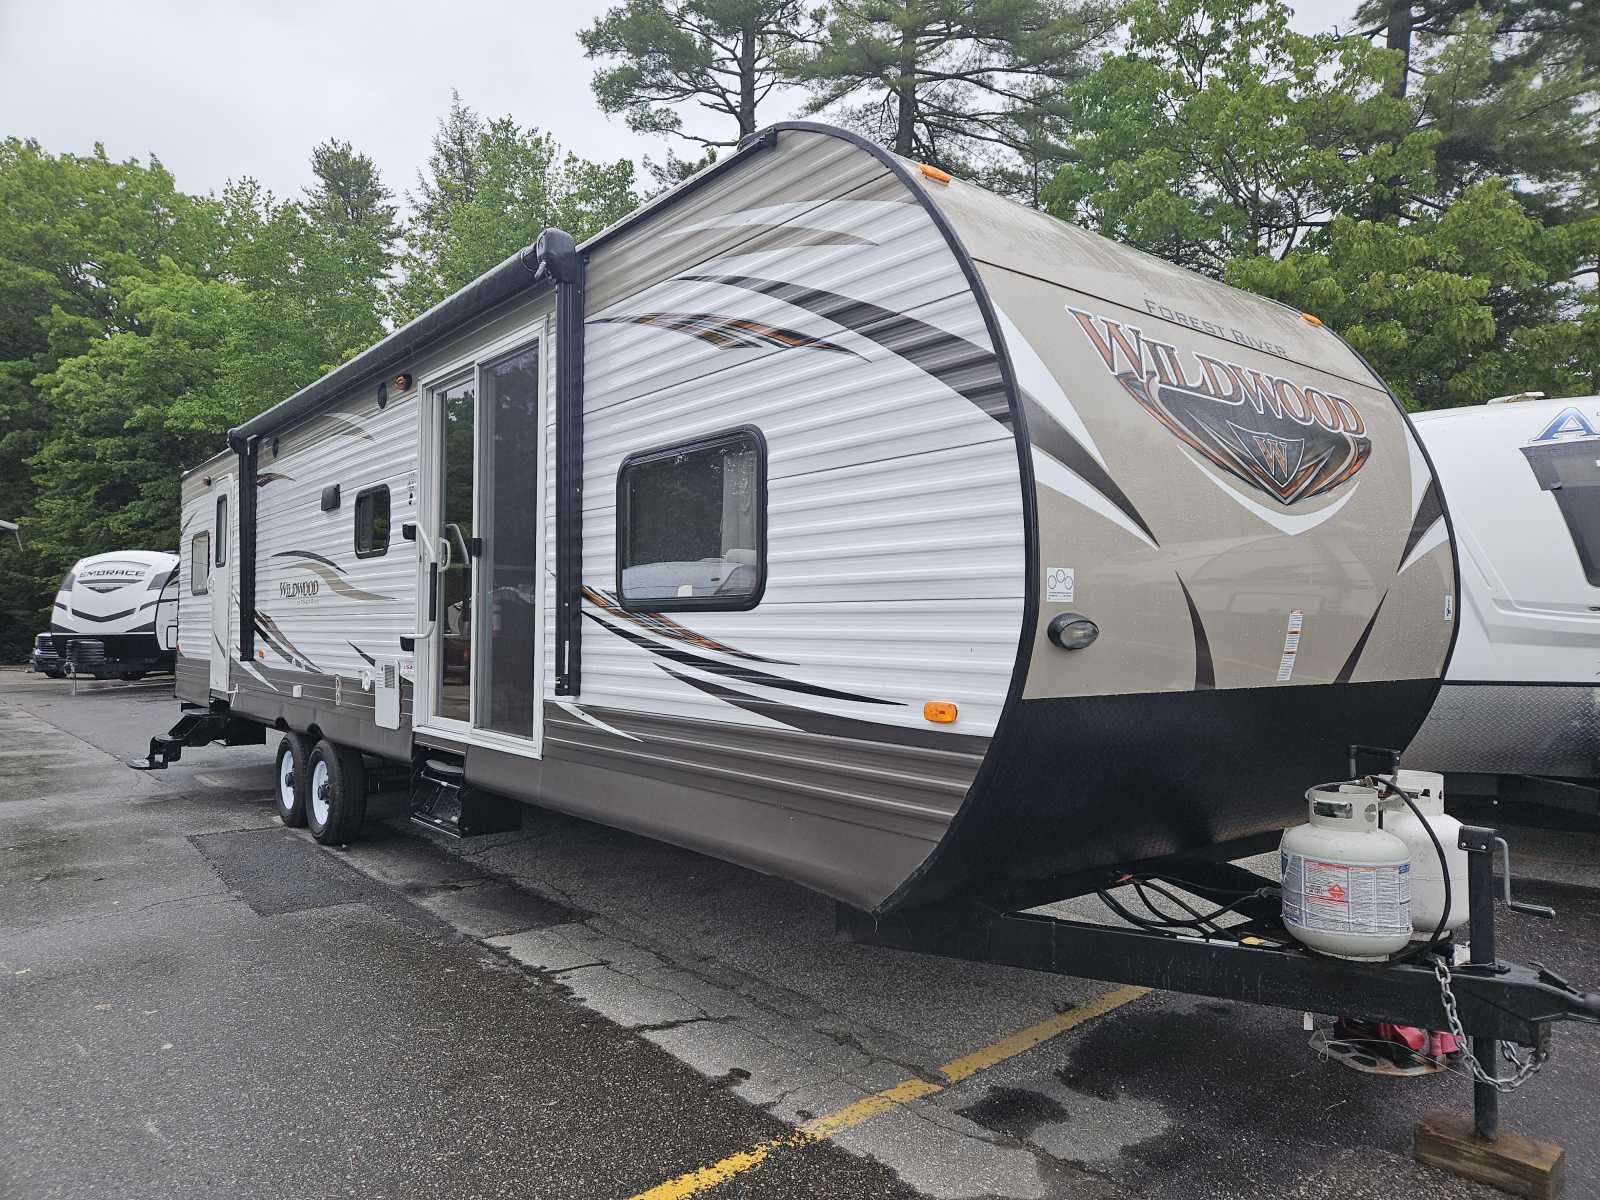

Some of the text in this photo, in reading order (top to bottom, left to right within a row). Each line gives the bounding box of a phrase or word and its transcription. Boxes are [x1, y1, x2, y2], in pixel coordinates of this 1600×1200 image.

[1143, 299, 1289, 359] FOREST RIVER
[1064, 304, 1369, 439] WILDWOOD
[79, 569, 145, 578] EMBRACE
[279, 580, 320, 598] WILDWOOD
